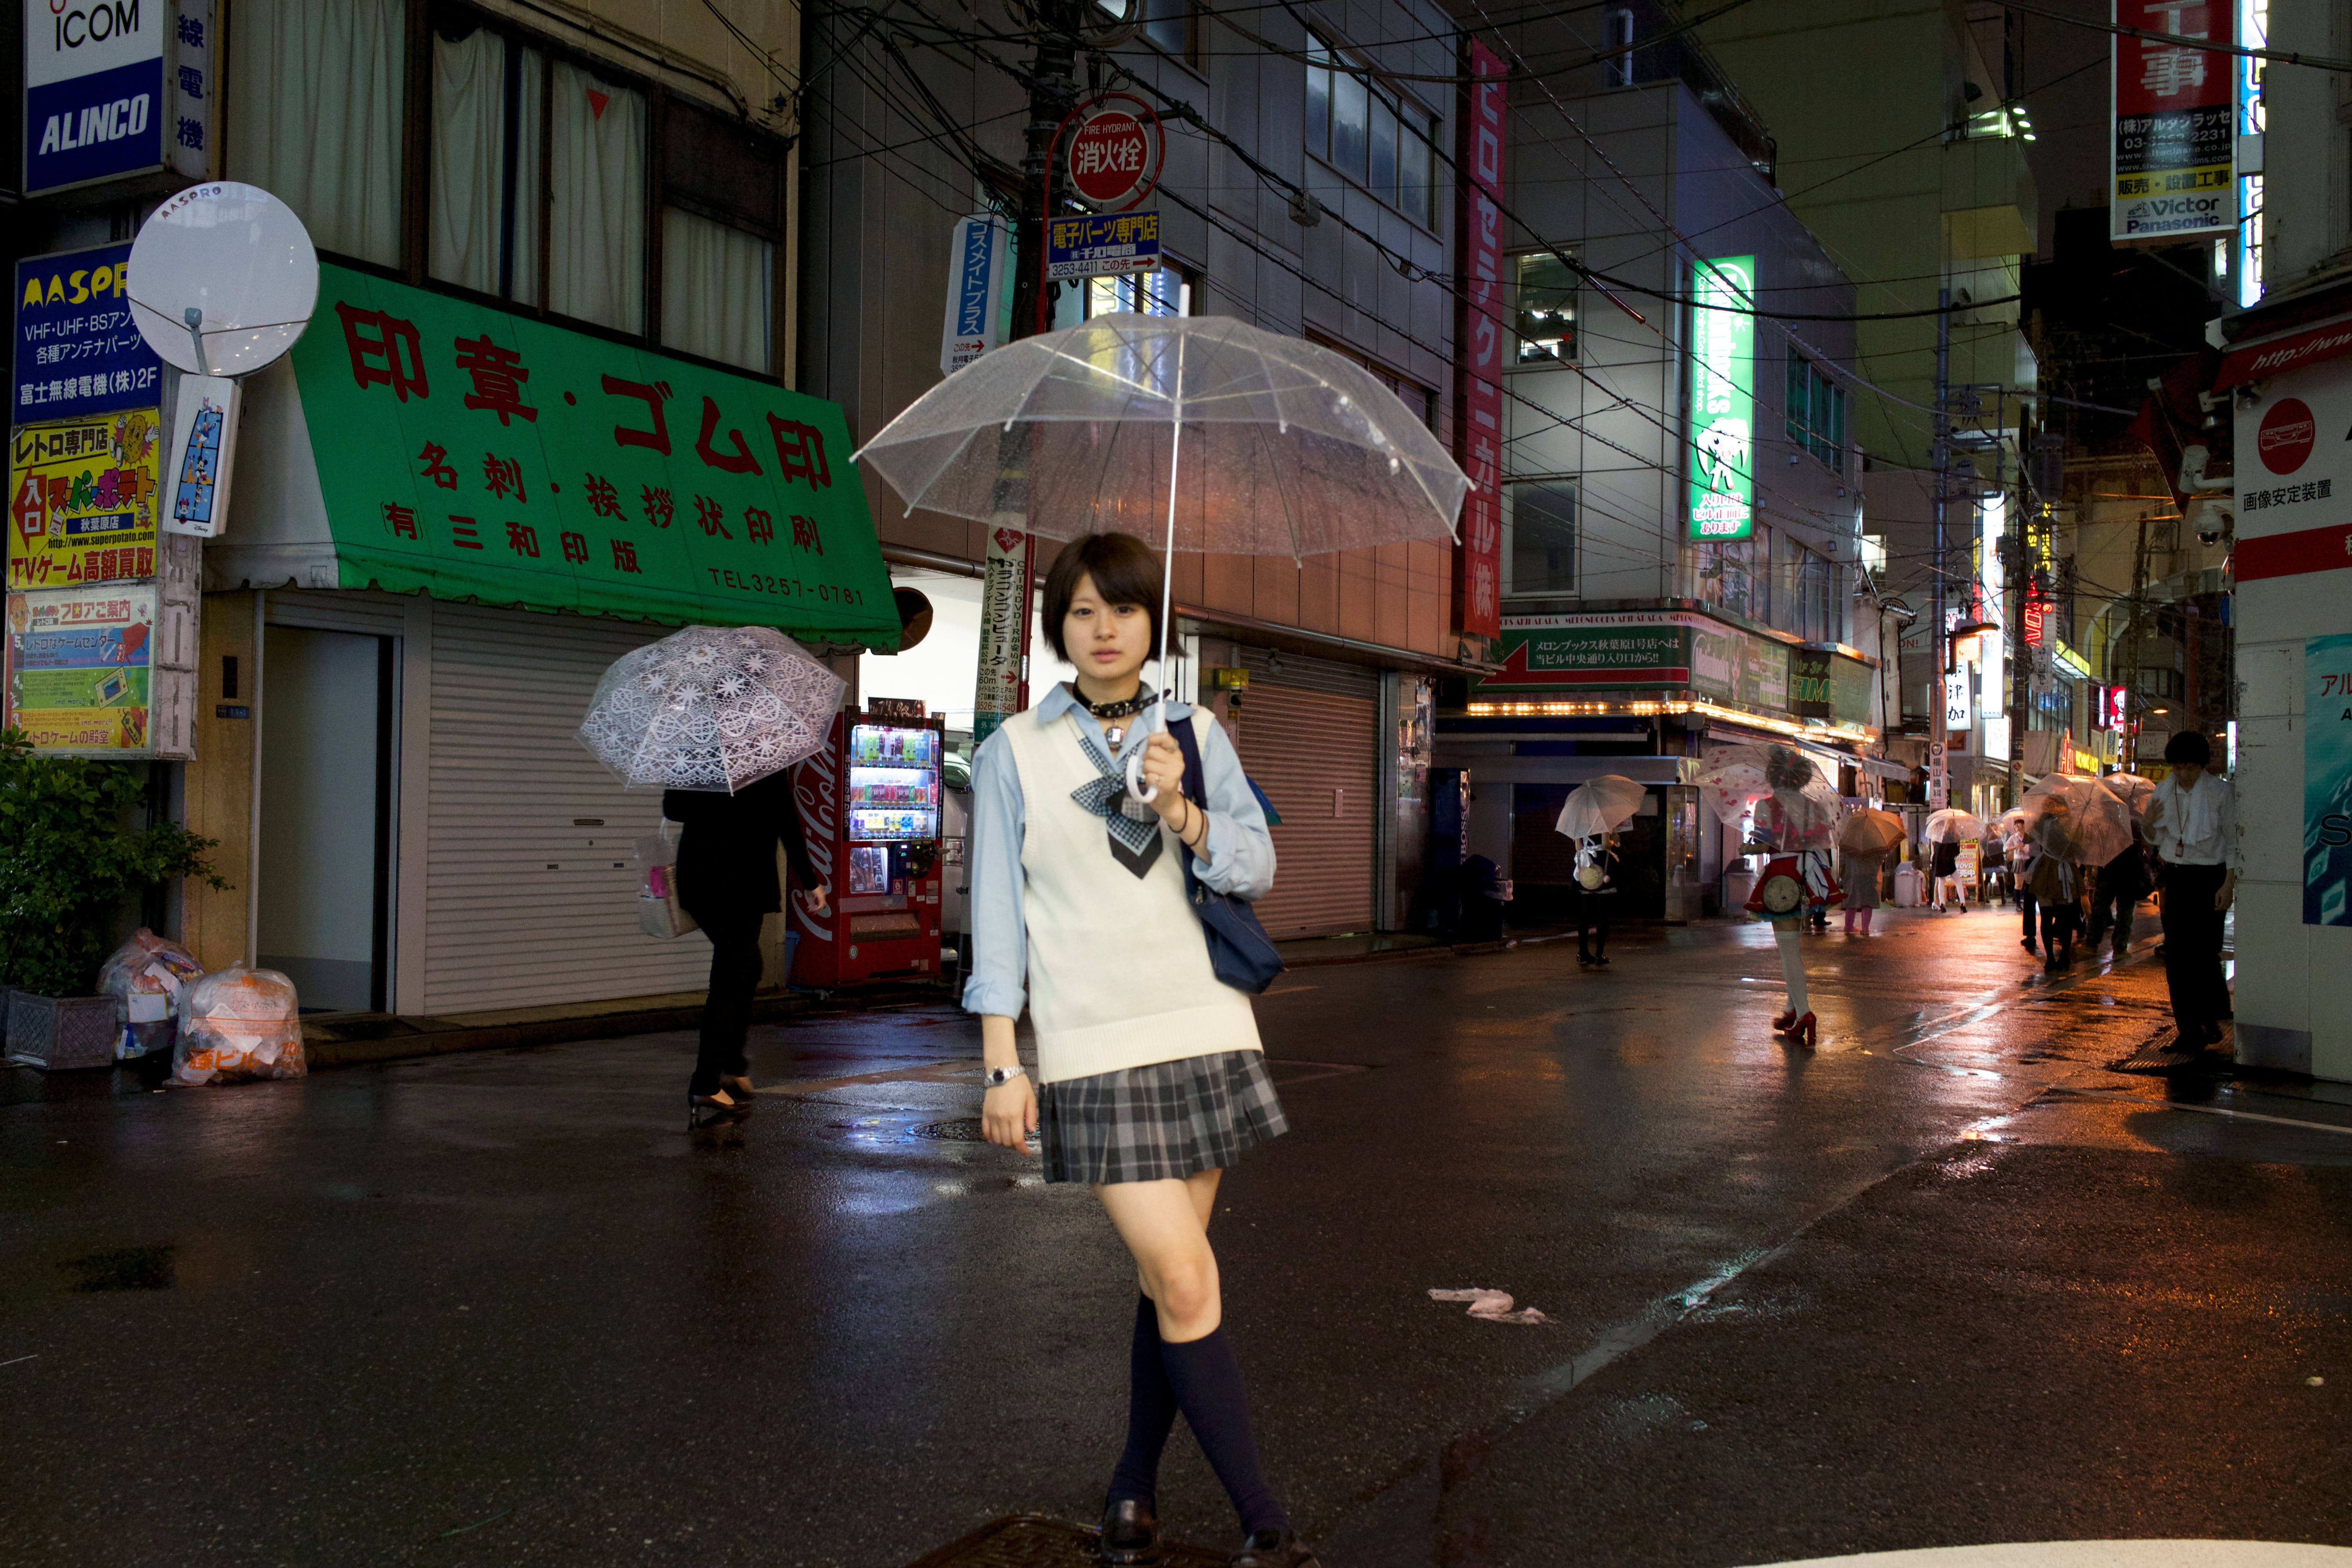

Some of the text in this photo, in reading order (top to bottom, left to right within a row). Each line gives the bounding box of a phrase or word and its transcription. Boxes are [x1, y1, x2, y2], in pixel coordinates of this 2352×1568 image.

[177, 14, 204, 152] 線電機
[38, 93, 150, 155] ALINCO
[1085, 122, 1136, 135] FIRE HYDRANT
[1077, 138, 1142, 174] 消火栓
[2118, 169, 2229, 195] 販売・設置工事
[161, 186, 221, 220] MASPRO
[2151, 198, 2219, 217] Victor
[1053, 214, 1158, 249] 電子パーツ専門店
[2127, 213, 2219, 233] Panasonic
[962, 223, 987, 334] コスメイトプラス
[1053, 261, 1098, 276] 3253-4411
[1102, 259, 1130, 270] この先
[25, 312, 136, 341] VHF・UHF・BSアン
[36, 334, 142, 365] 各種アンテナパーツ
[954, 343, 971, 352] この先
[1706, 274, 1737, 414] Melonbooks
[20, 367, 156, 405] 富士無線電機(株)2F
[335, 300, 831, 492] 印章・ゴム印
[16, 428, 108, 464] レトロ専門店
[24, 479, 42, 533] 入口
[418, 440, 822, 556] 名刺・挨拶状印刷
[2243, 479, 2331, 512] 画像安定装置
[49, 531, 154, 549] http://www.superpotato.com
[81, 516, 119, 532] 秋葉原店
[194, 524, 209, 533] Disney
[1701, 521, 1740, 534] あります
[11, 548, 153, 586] TVゲーム高額買取
